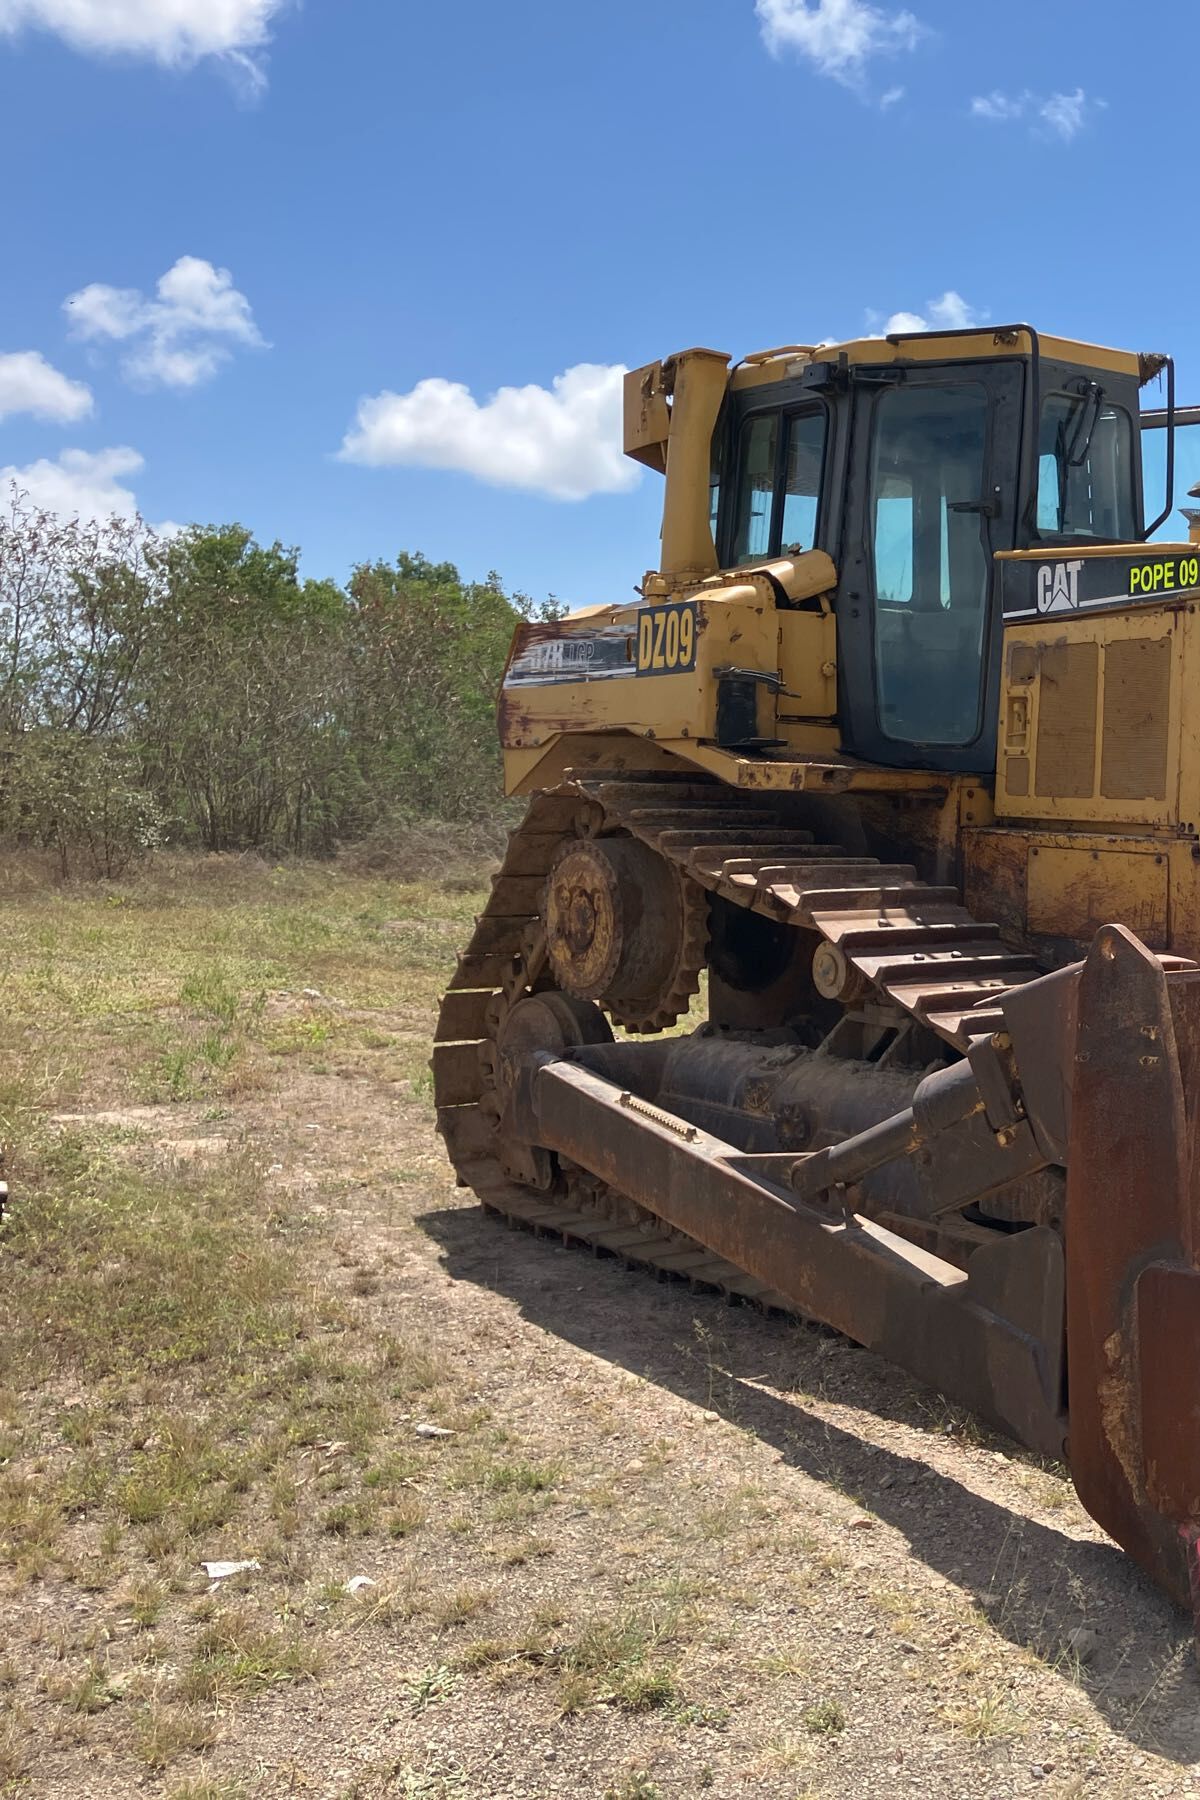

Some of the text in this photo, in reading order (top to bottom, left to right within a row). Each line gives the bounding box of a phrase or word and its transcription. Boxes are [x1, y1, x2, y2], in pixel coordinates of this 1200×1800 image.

[1037, 561, 1082, 613] CAT
[1130, 558, 1199, 593] POPE 09
[638, 608, 694, 670] DZ09
